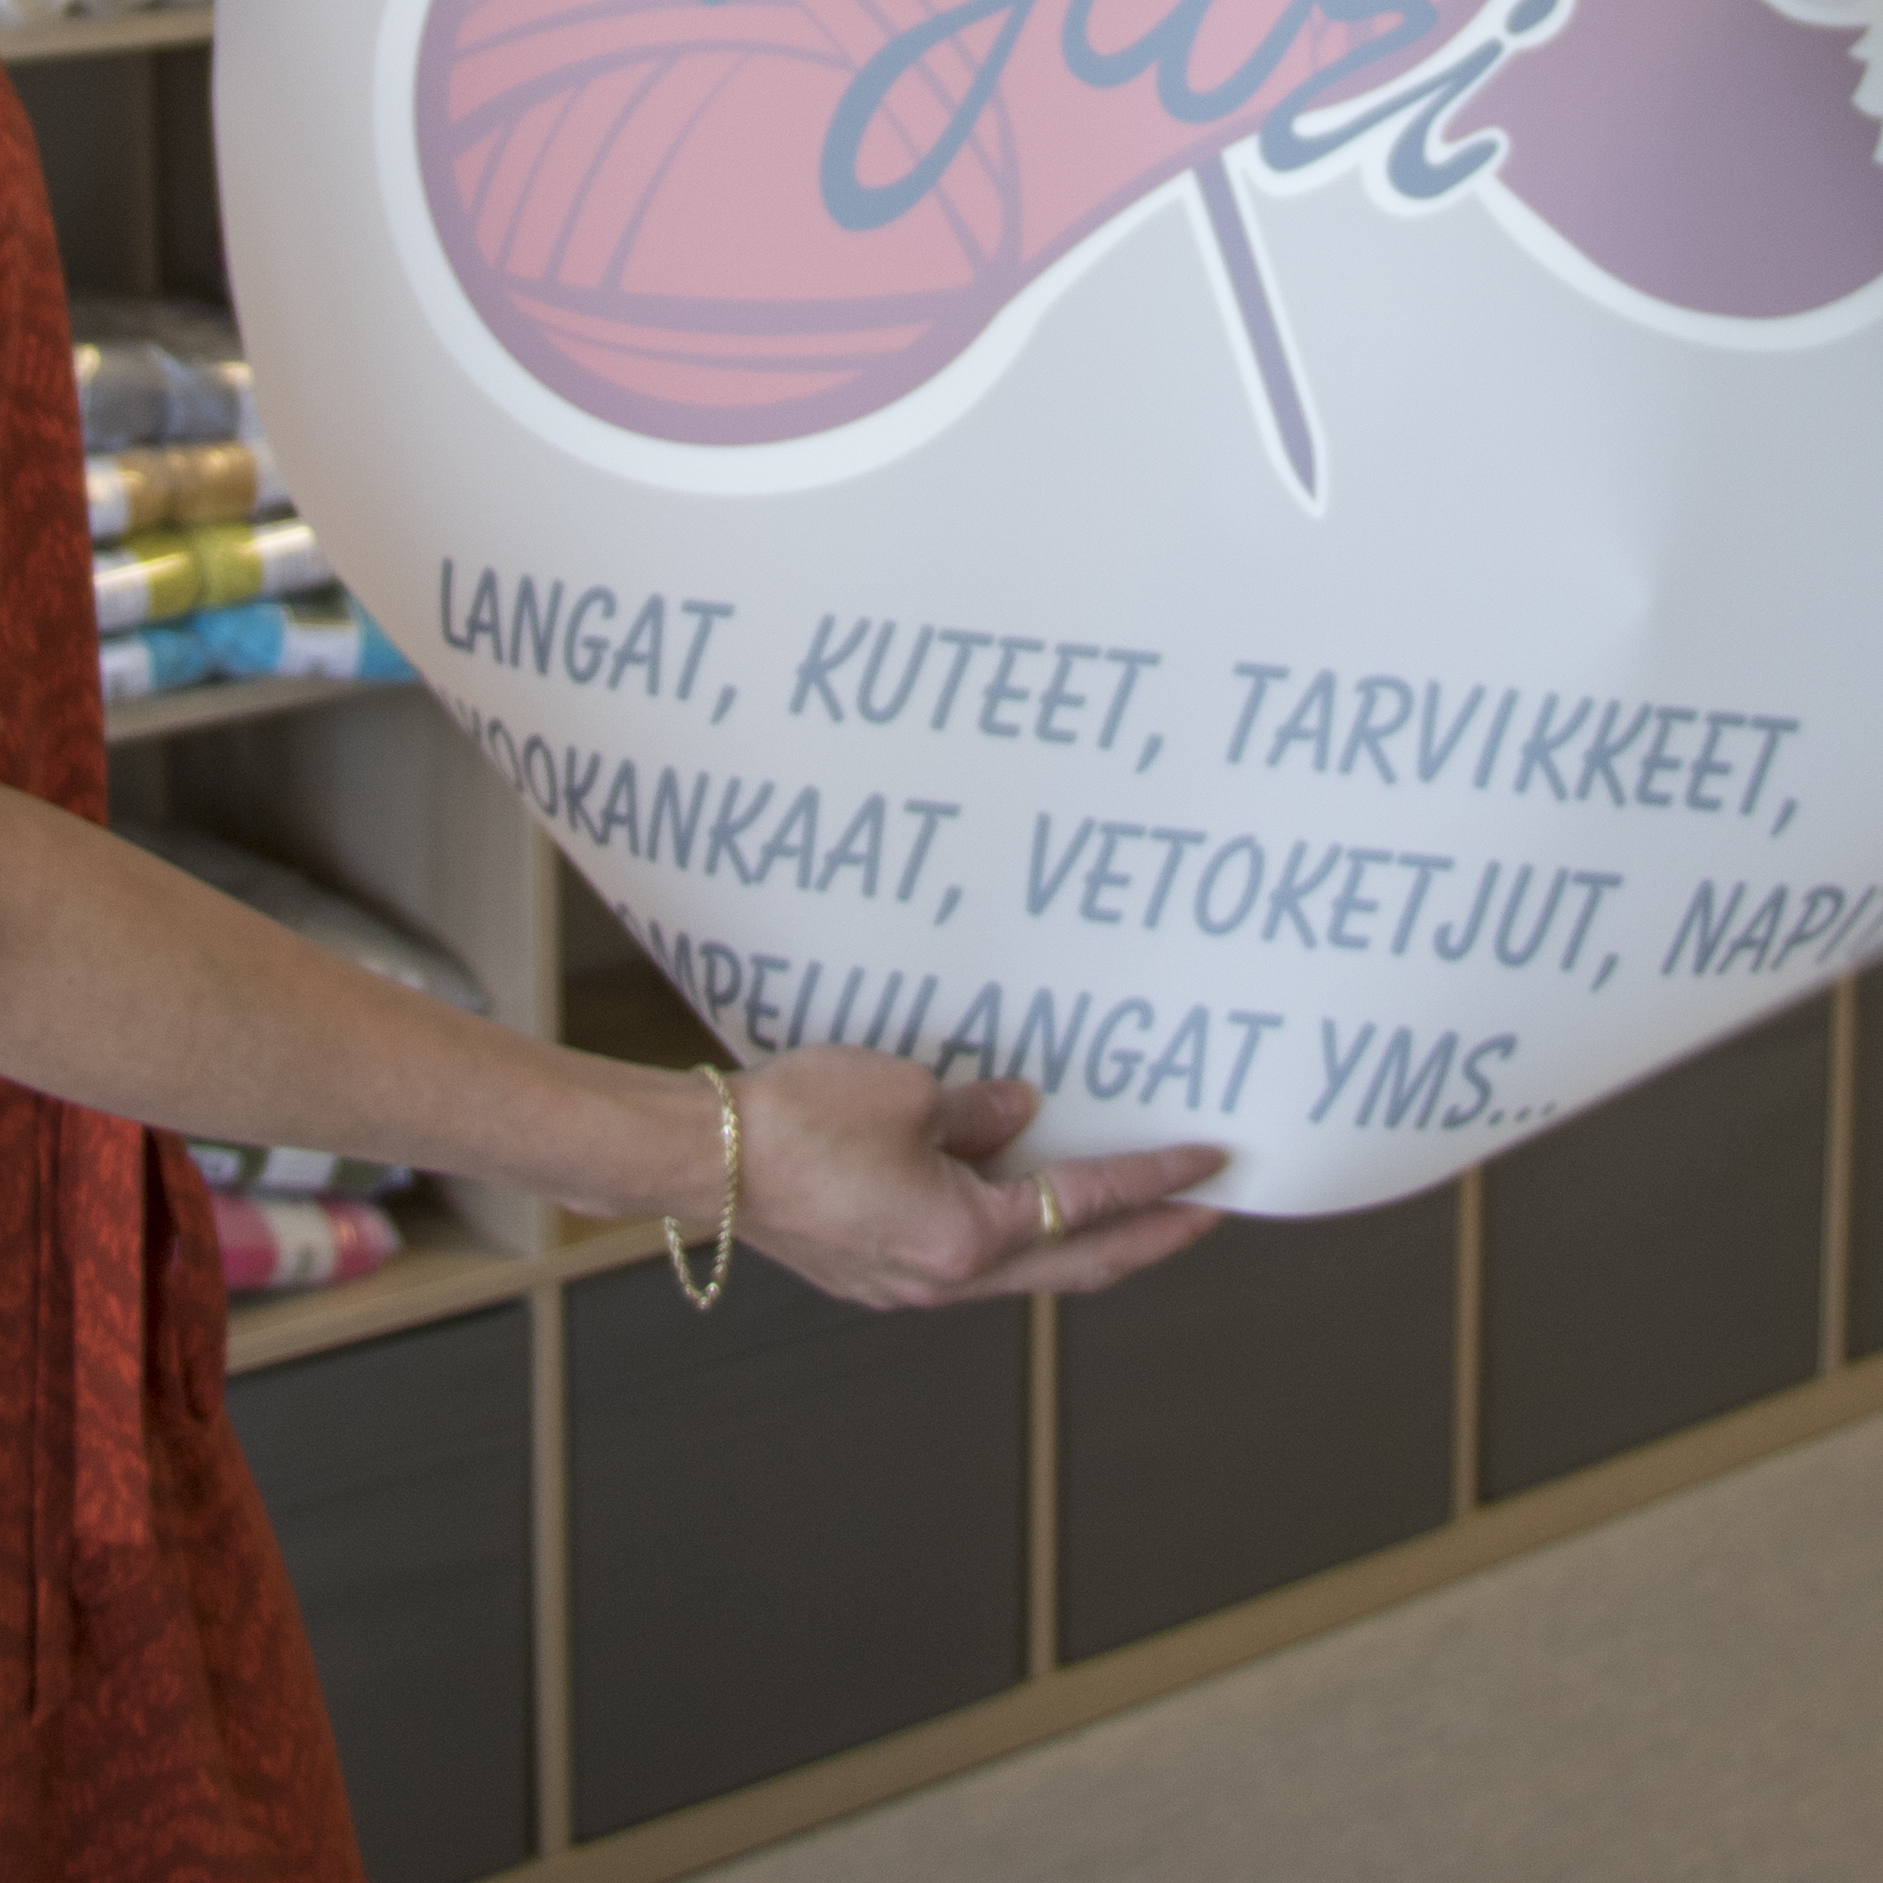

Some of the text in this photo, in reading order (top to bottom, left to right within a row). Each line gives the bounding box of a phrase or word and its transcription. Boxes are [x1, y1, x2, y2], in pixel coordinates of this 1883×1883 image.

[439, 558, 1801, 838] LANGAT, KUTEET, TARVIKKEET,
[1025, 811, 1623, 993] VETOKETJUT,
[1309, 1015, 1558, 1130] YMS...
